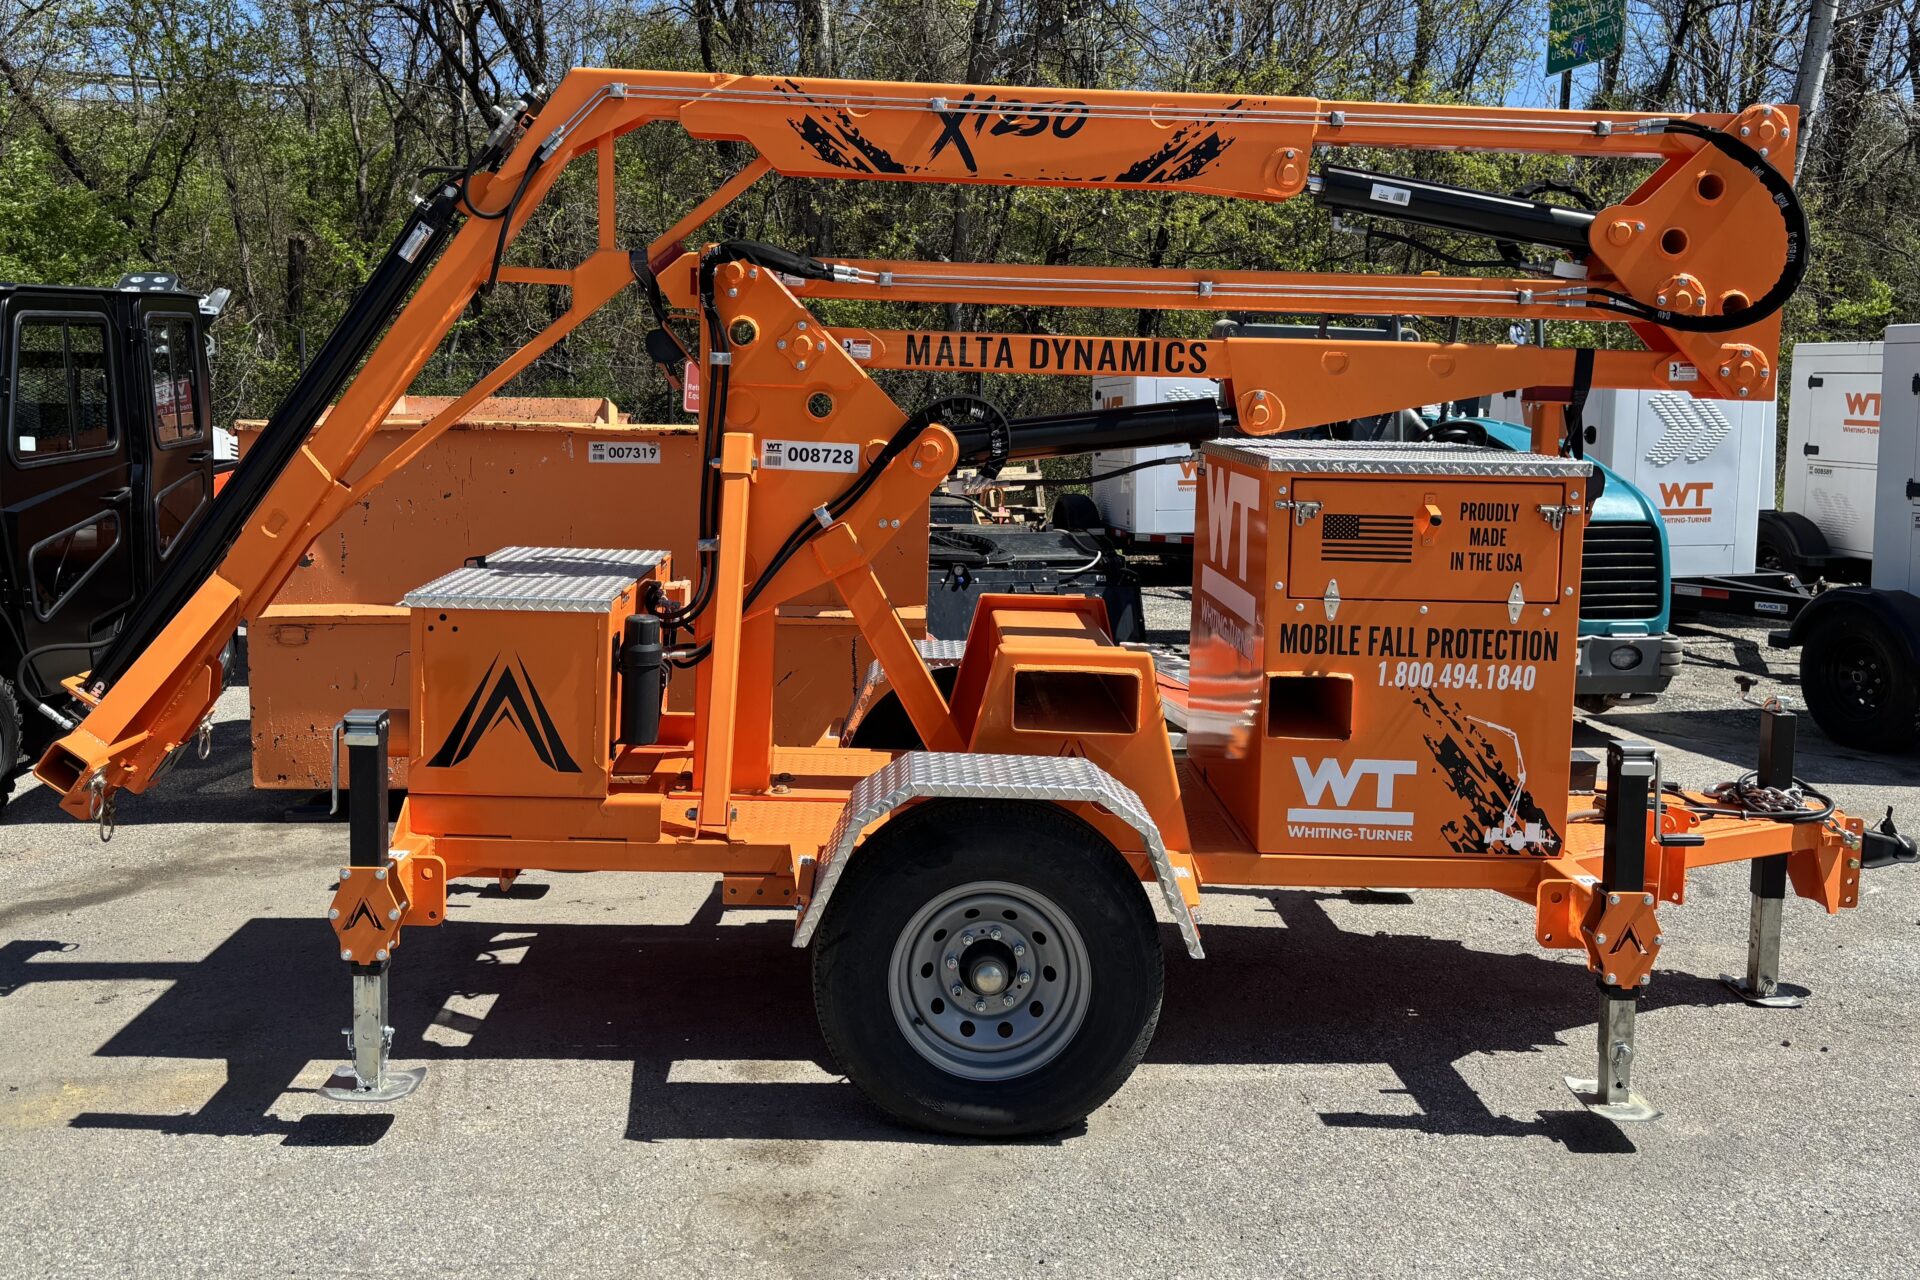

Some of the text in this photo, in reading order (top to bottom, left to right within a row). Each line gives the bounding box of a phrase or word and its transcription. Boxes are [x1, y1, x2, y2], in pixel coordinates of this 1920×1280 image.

[926, 90, 1089, 173] X1250
[905, 334, 1014, 369] MALTA
[1029, 338, 1207, 374] DYNAMICS
[608, 446, 657, 459] 007319
[767, 442, 854, 465] WT 008728
[1659, 482, 1714, 507] WT
[1206, 463, 1260, 583] WT
[1460, 502, 1520, 522] PROUDLY
[1663, 516, 1712, 524] HITING-TURNER
[1469, 527, 1507, 546] MADE
[1450, 551, 1523, 572] IN THE USA
[1280, 623, 1559, 661] MOBILE FALL PROTECTION
[1378, 661, 1537, 691] 1.800.494.1840
[1291, 756, 1418, 809] WT
[1287, 824, 1413, 841] WHITING-TURNER
